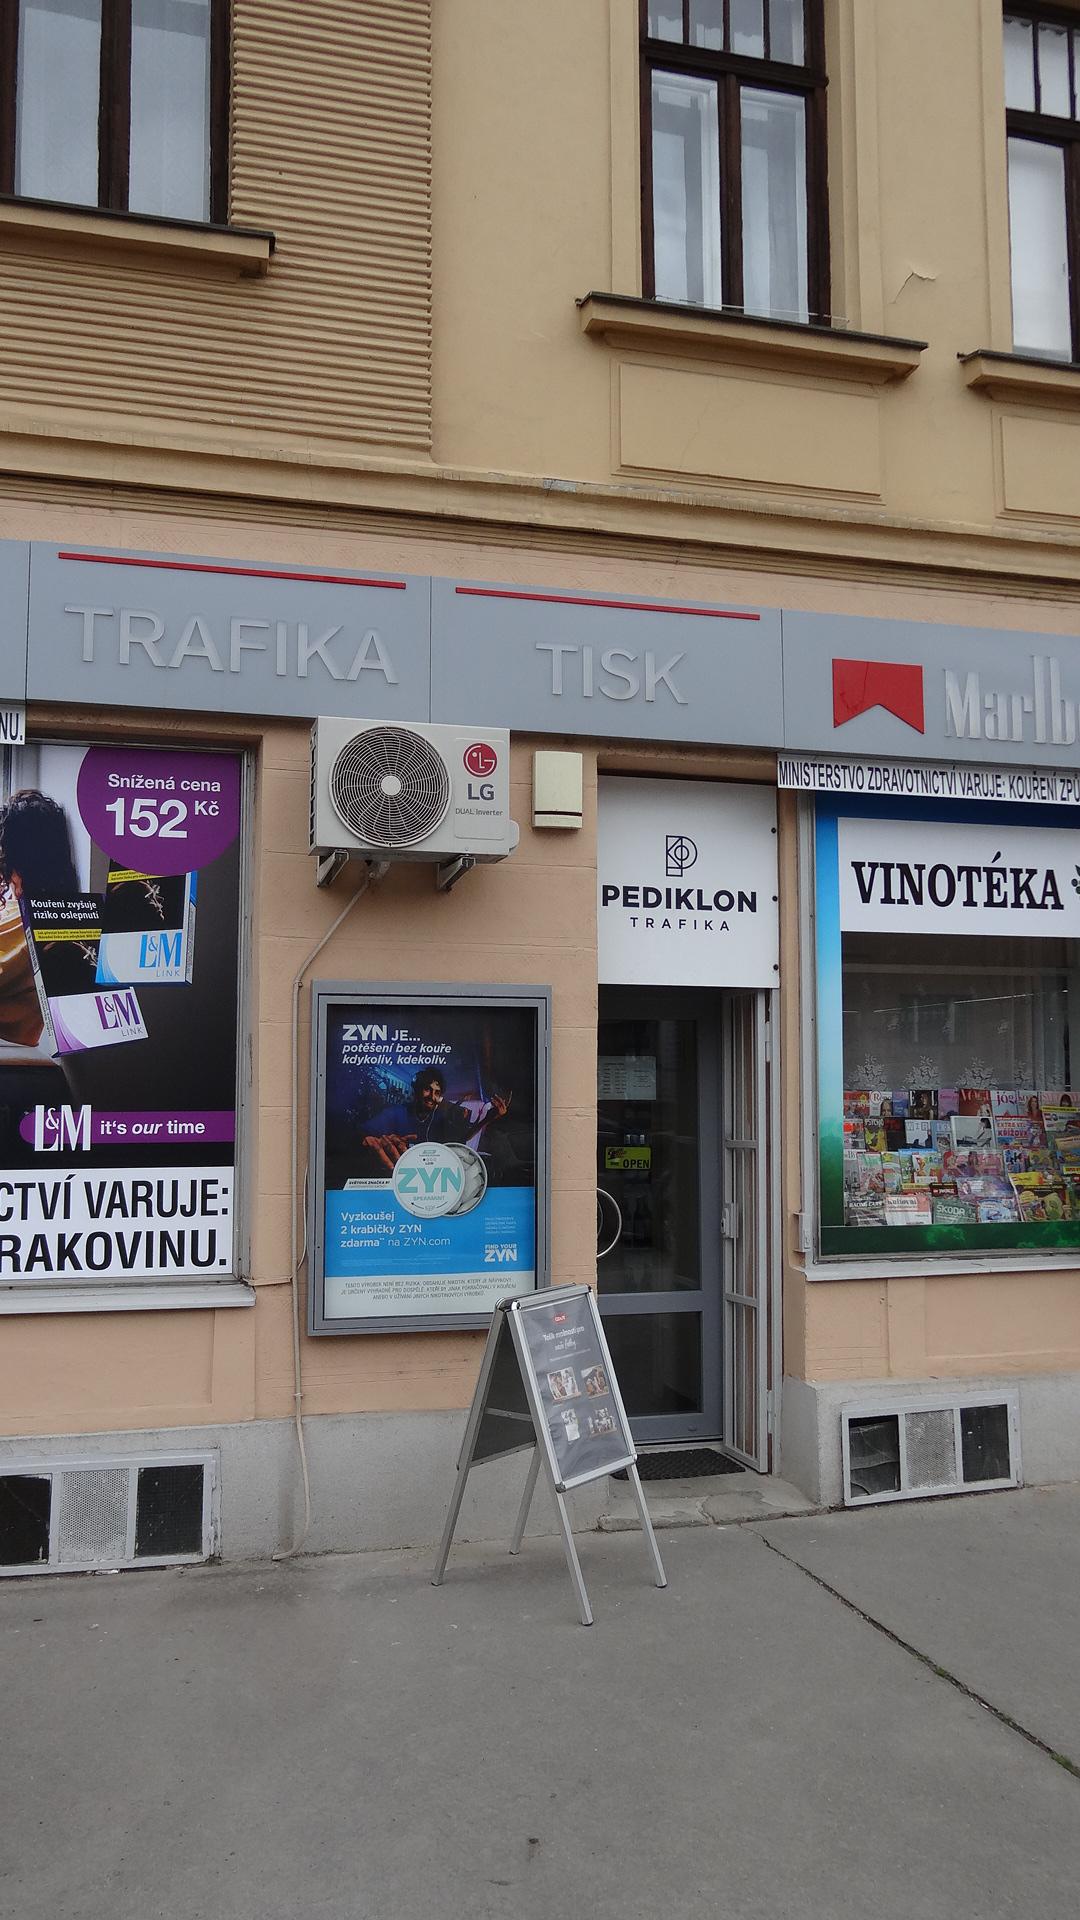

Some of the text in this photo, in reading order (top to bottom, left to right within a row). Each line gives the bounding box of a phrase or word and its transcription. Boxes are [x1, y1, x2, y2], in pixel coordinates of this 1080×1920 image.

[64, 602, 399, 684] TRAFIKA
[535, 641, 689, 705] TISK
[107, 773, 221, 792] Snížená cena
[779, 761, 865, 789] MINISTERSTVO
[868, 765, 957, 795] ZDRAVOTNICTVÍ
[959, 772, 1006, 798] VARUJE:
[1008, 770, 1058, 800] KOUŘENÍ
[467, 783, 495, 801] LG
[105, 797, 220, 839] 152 Kč
[476, 808, 503, 816] Inverter
[850, 850, 1065, 911] VINOTÉKA
[30, 899, 97, 911] Kouření zvyšuje
[602, 884, 757, 913] PEDIKLON
[33, 910, 59, 919] riziko
[630, 917, 730, 932] TRAFIKA
[139, 932, 183, 968] L&M
[156, 969, 181, 978] LINK
[94, 991, 141, 1030] L&M
[121, 1027, 144, 1037] LINK
[342, 1024, 421, 1041] ZYN JE...
[342, 1043, 452, 1054] potěšení bez kouře
[342, 1055, 447, 1066] kdykoliv, kdekoliv.
[34, 1104, 206, 1151] L&M it's our time
[623, 1159, 649, 1169] OPEN
[397, 1167, 462, 1194] ZYN
[84, 1178, 229, 1219] VARUJE:
[340, 1211, 395, 1223] Vyzkoušej
[340, 1224, 422, 1235] 2 krabičky ZYN
[403, 1237, 451, 1247] ZYN.com
[0, 1229, 227, 1273] RAKOVINU.
[484, 1249, 518, 1263] ZYN
